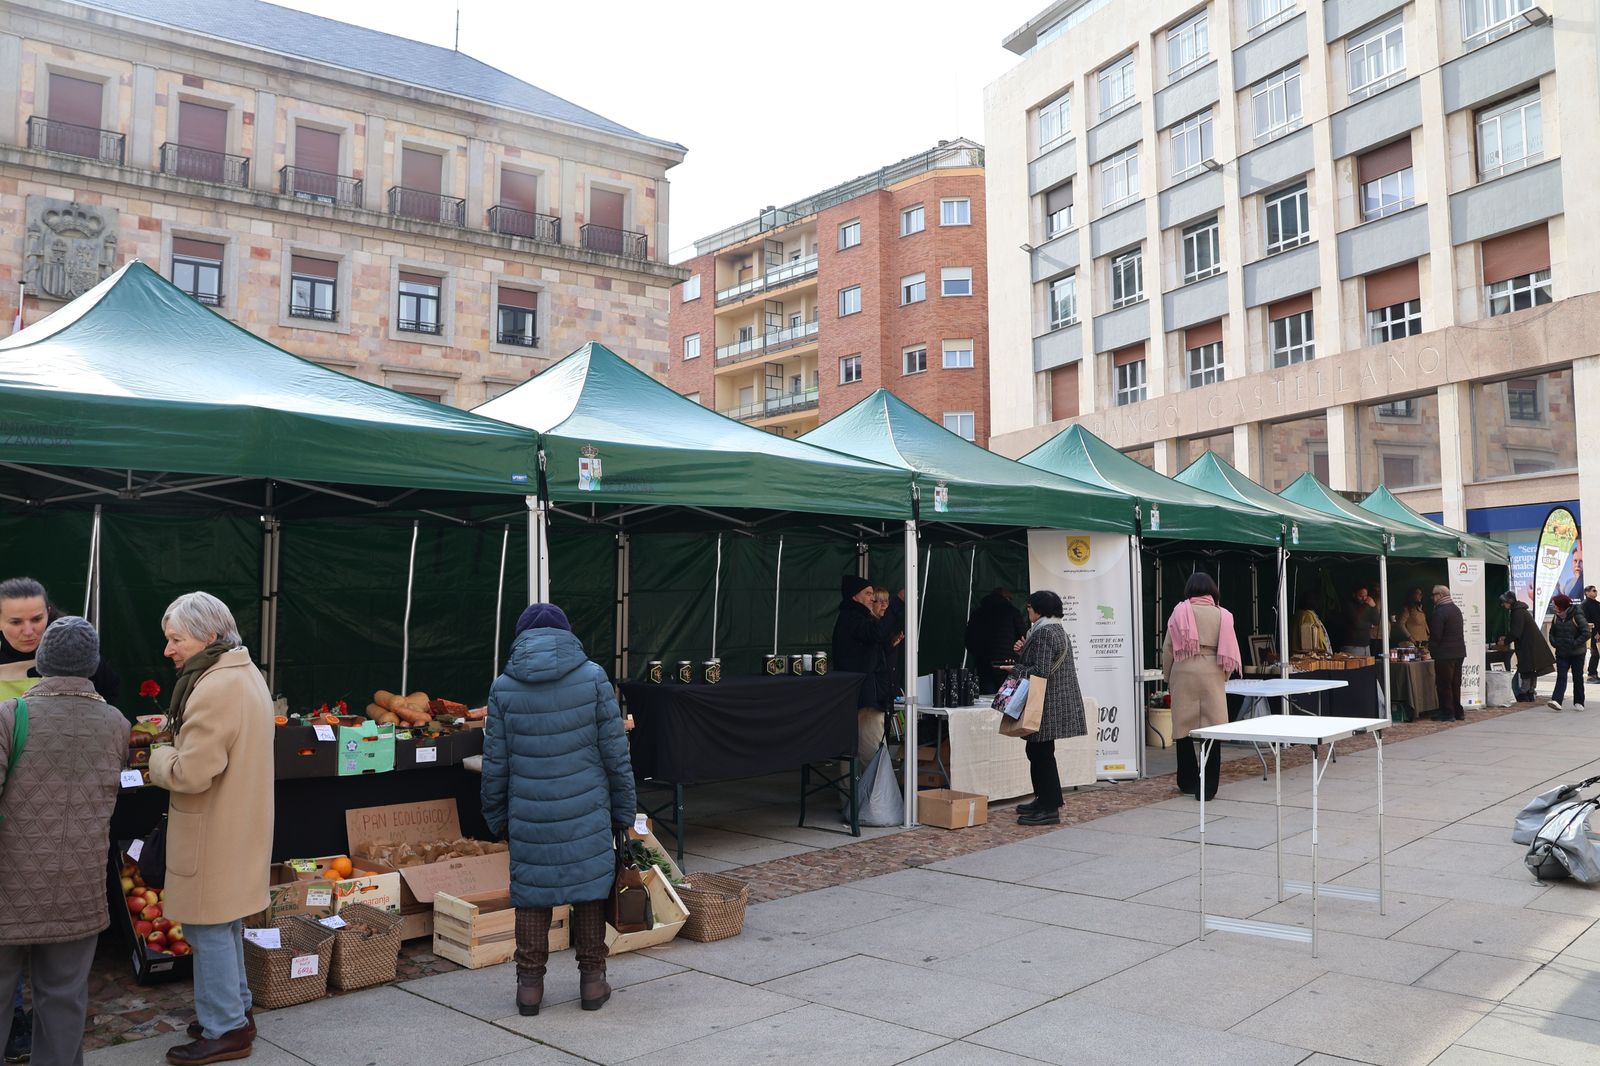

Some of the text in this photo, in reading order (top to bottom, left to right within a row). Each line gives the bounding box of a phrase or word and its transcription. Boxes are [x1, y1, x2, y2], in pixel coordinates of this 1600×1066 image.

[1094, 347, 1439, 440] BANCO CASTELLANO
[363, 813, 387, 831] PAN
